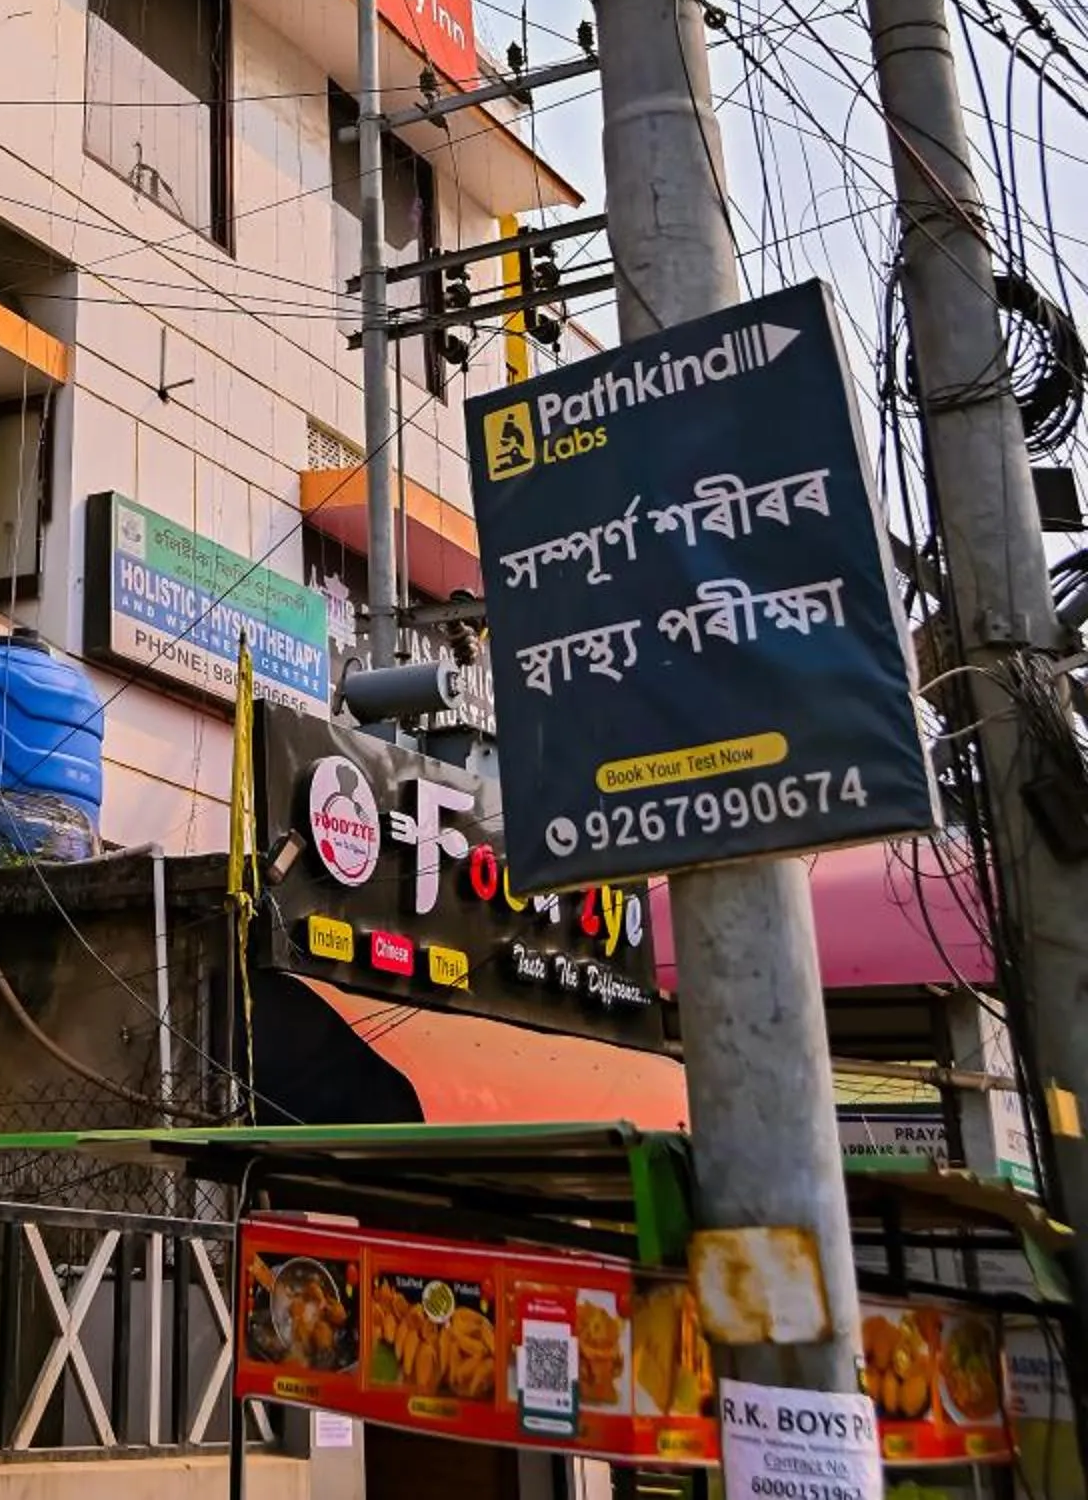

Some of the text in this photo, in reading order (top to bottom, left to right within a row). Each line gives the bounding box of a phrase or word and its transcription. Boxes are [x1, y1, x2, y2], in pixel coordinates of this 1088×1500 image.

[536, 332, 739, 436] Pathkind
[542, 426, 607, 465] Labs
[647, 468, 831, 547] শৰীৰৰ
[120, 560, 196, 619] HOLISTIC
[200, 598, 323, 677] PHYSIOTHERAPY
[121, 597, 320, 692] AND WELLNE CENTRE
[657, 577, 846, 653] পৰীক্ষা
[605, 747, 755, 787] Book Your Test Now
[584, 765, 869, 851] 9267990674
[513, 942, 547, 979] Taste
[723, 1398, 767, 1430] R.K.
[777, 1406, 848, 1439] BOYS
